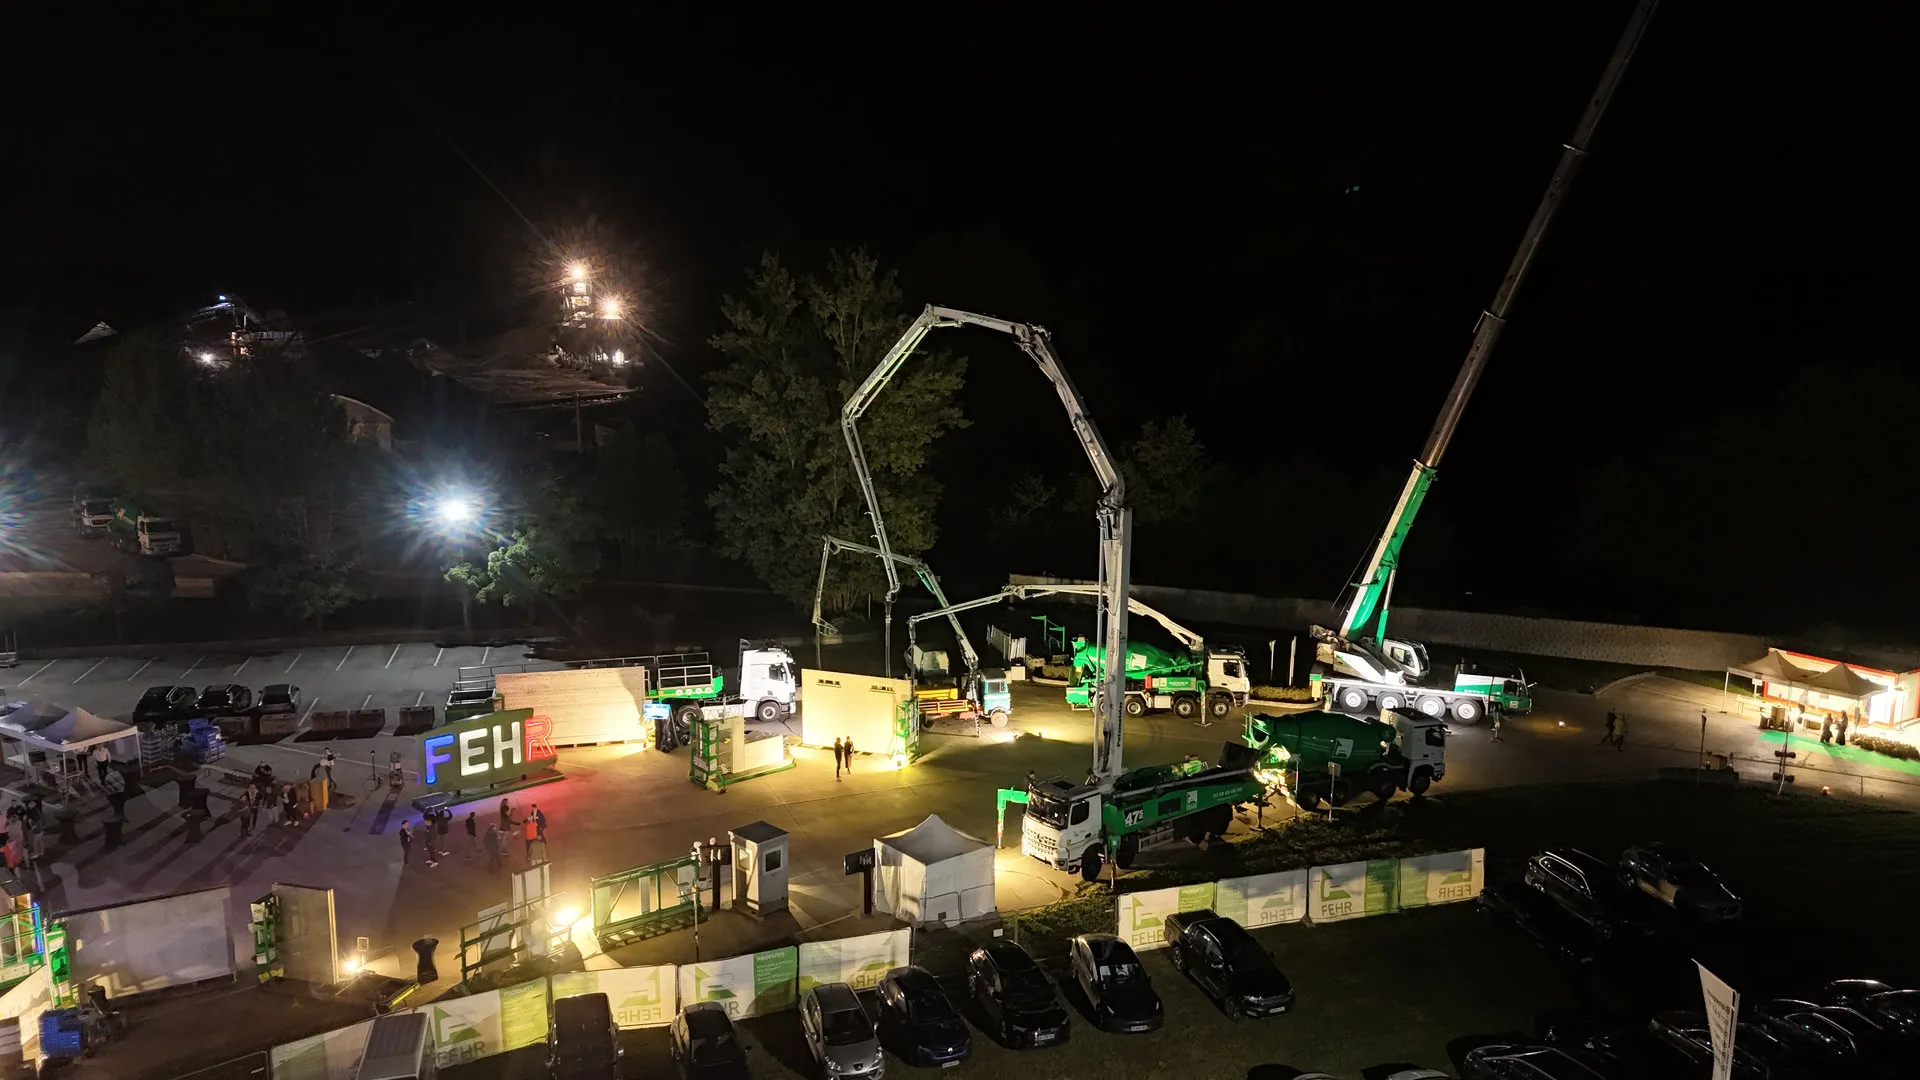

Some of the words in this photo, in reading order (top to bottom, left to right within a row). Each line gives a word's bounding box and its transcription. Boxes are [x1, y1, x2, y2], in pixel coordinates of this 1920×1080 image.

[424, 715, 553, 785] FEHR
[1321, 901, 1352, 917] FEHR
[1132, 929, 1164, 944] FEHR
[437, 1040, 486, 1064] FEHR
